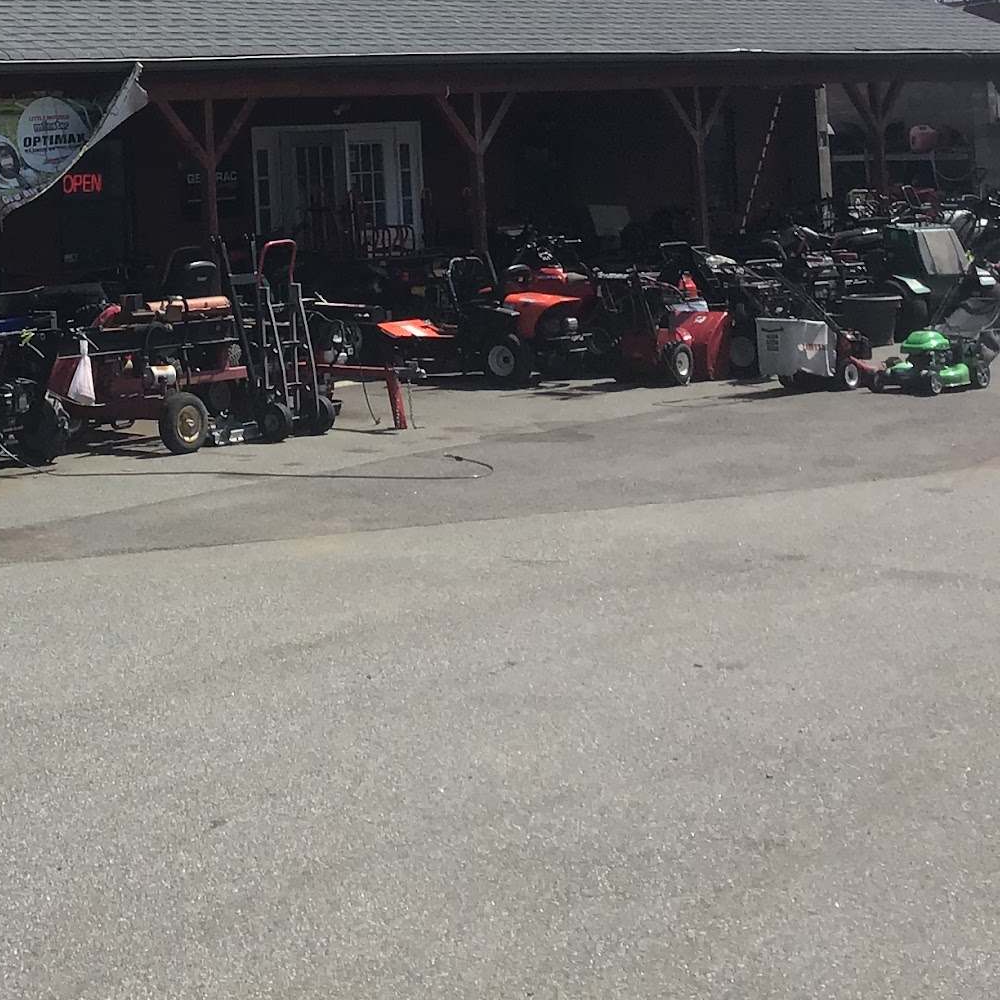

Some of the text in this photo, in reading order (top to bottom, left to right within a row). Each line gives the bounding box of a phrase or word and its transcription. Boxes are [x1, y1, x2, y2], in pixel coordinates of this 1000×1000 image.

[23, 133, 85, 148] OPTIMAX
[62, 173, 102, 194] OPEN
[187, 170, 238, 184] GERAC
